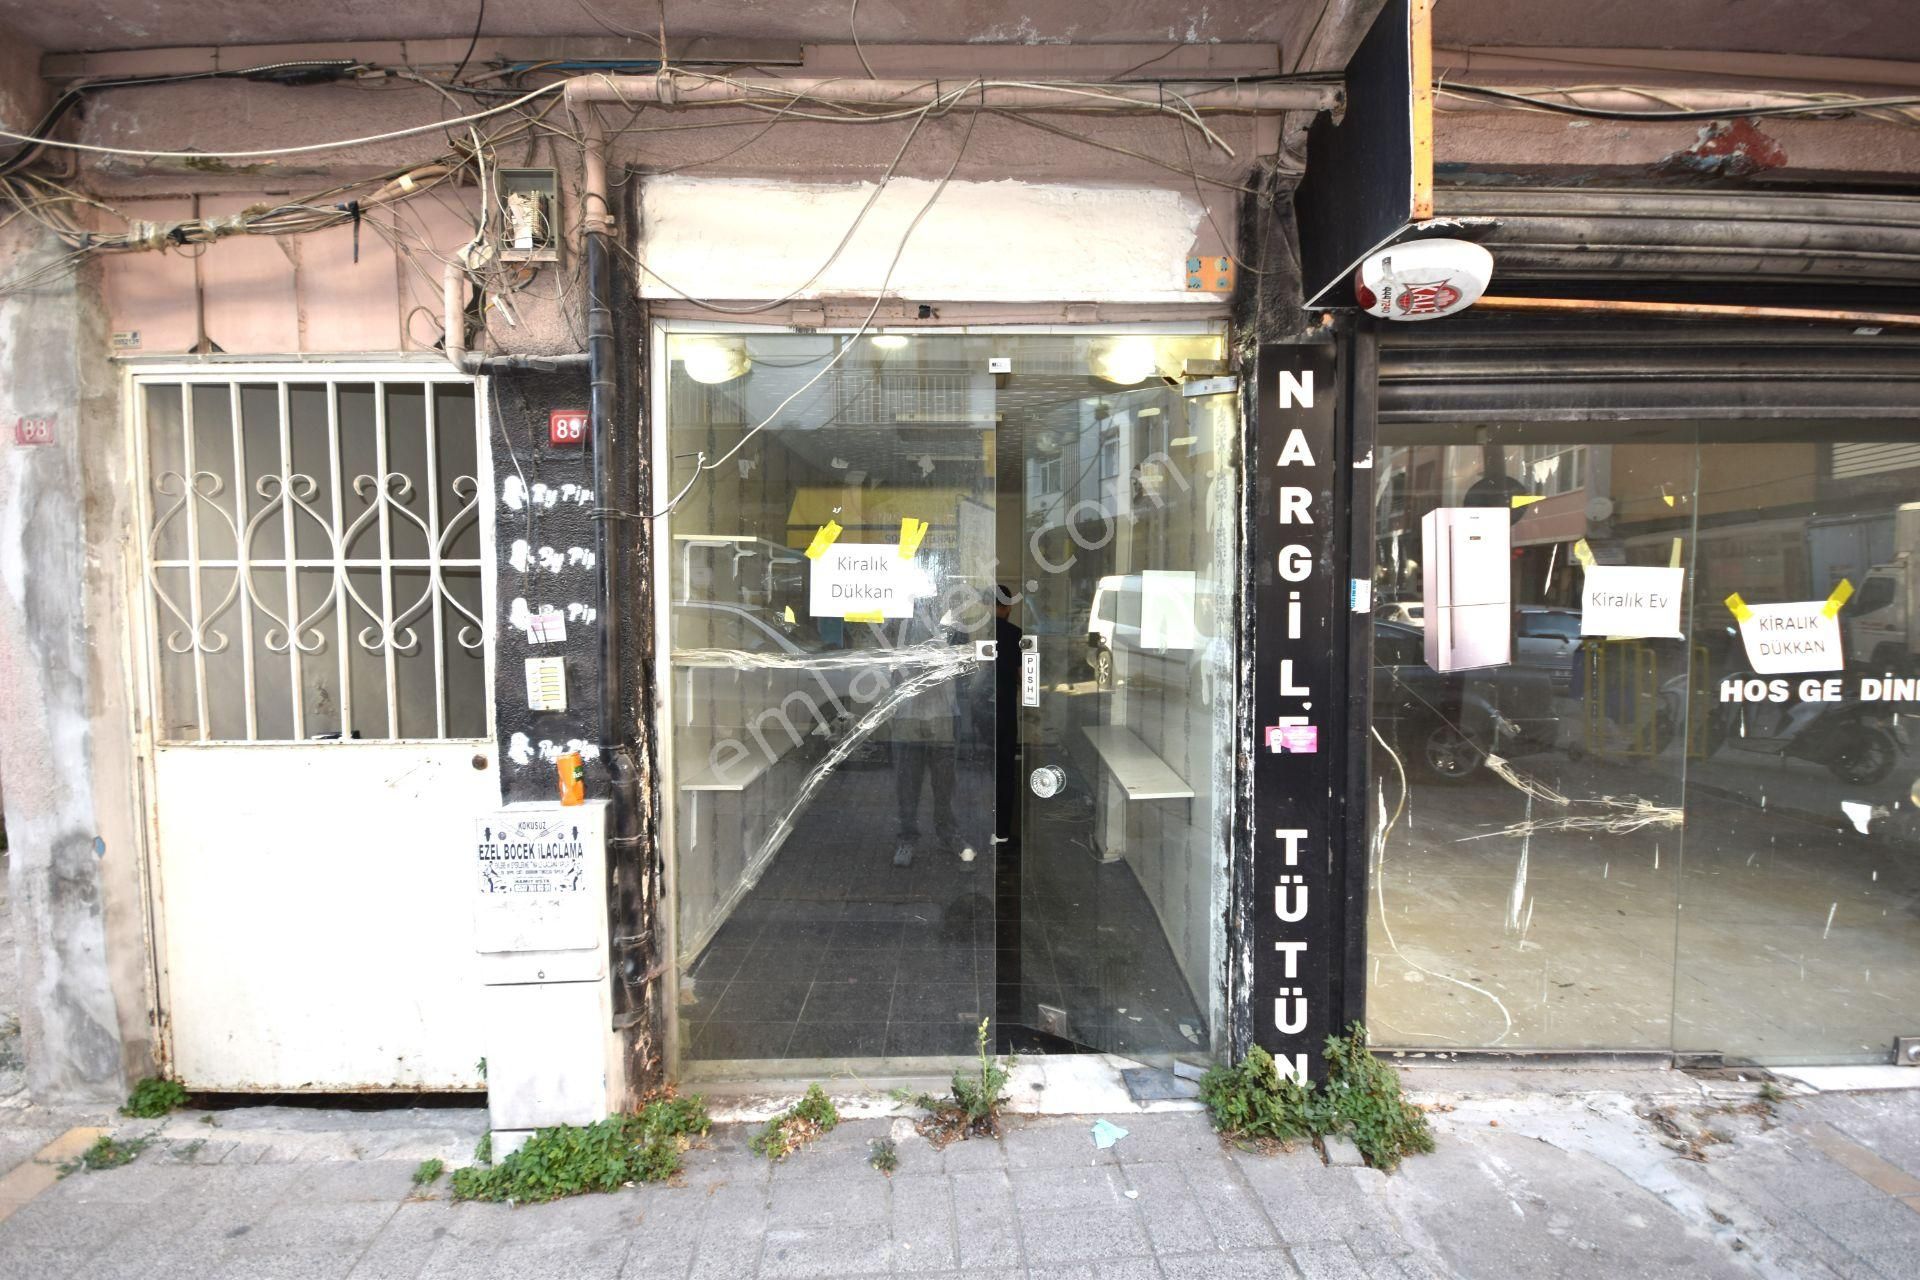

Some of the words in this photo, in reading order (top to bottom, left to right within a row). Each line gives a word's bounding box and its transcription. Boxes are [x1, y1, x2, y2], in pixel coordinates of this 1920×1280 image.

[1404, 282, 1446, 314] KALE
[561, 483, 595, 507] Pip
[1277, 370, 1316, 727] NARGİL
[837, 556, 888, 572] Kiralık
[831, 583, 893, 599] Dükkan
[1592, 592, 1643, 608] Kiralık
[1650, 593, 1668, 608] Ev
[1759, 615, 1819, 632] KİRALIK
[1759, 640, 1825, 656] DÜKKAN
[1720, 679, 1790, 703] HOS
[518, 821, 547, 830] KOKUSUZ
[479, 844, 502, 860] EZEL
[1274, 828, 1309, 1088] TÜTÜN
